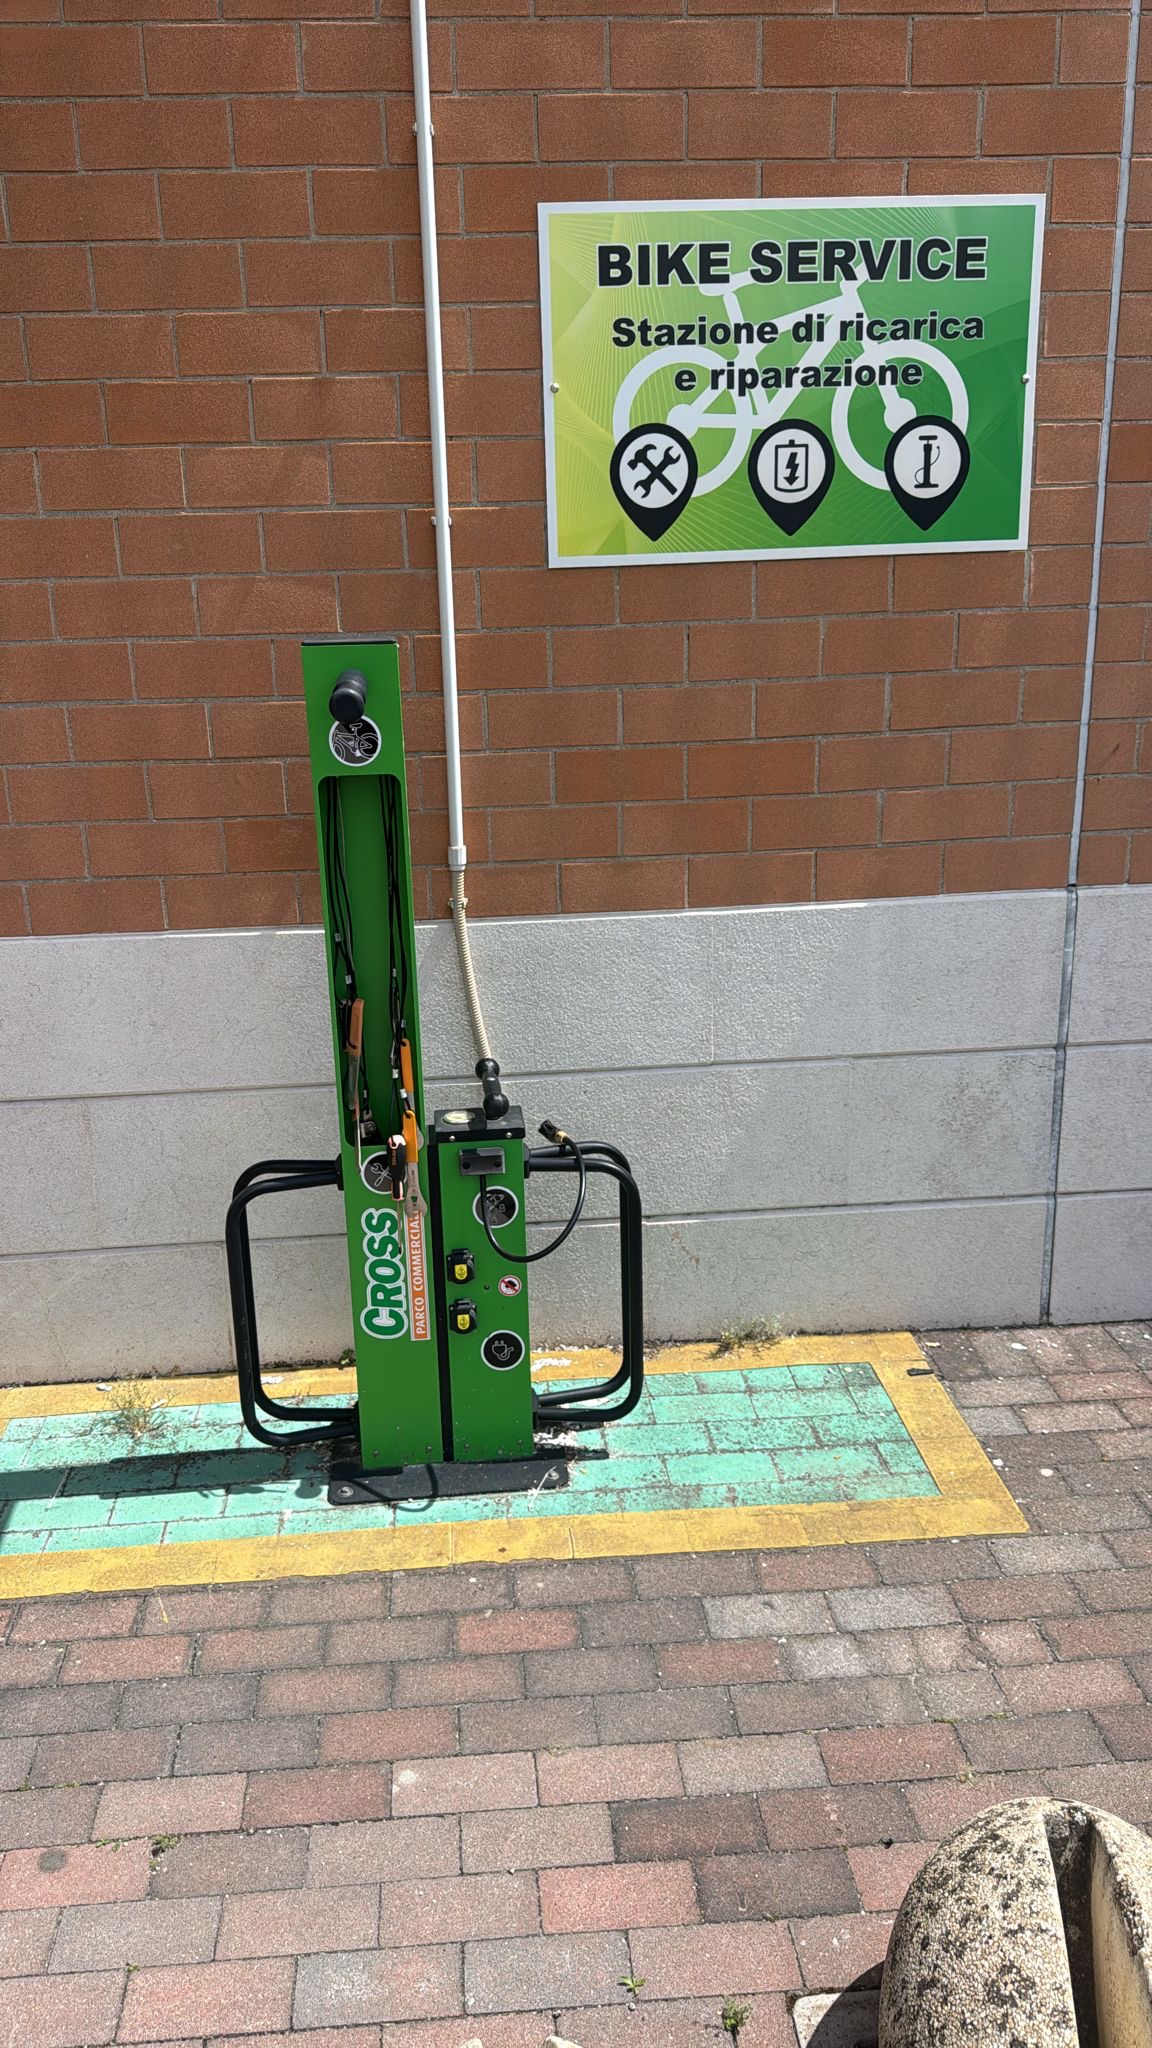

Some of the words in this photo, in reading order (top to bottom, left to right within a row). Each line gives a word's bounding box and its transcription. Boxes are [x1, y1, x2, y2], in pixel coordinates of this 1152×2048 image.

[598, 242, 731, 286] BIKE
[750, 237, 988, 283] SERVICE
[612, 316, 778, 348] Stazione
[792, 313, 825, 343] di
[839, 310, 984, 342] ricarica
[674, 365, 697, 392] e
[710, 358, 923, 397] riparazione
[410, 1210, 424, 1292] COMMERCIAL
[362, 1209, 407, 1338] CROSS
[415, 1297, 427, 1335] PARCO
